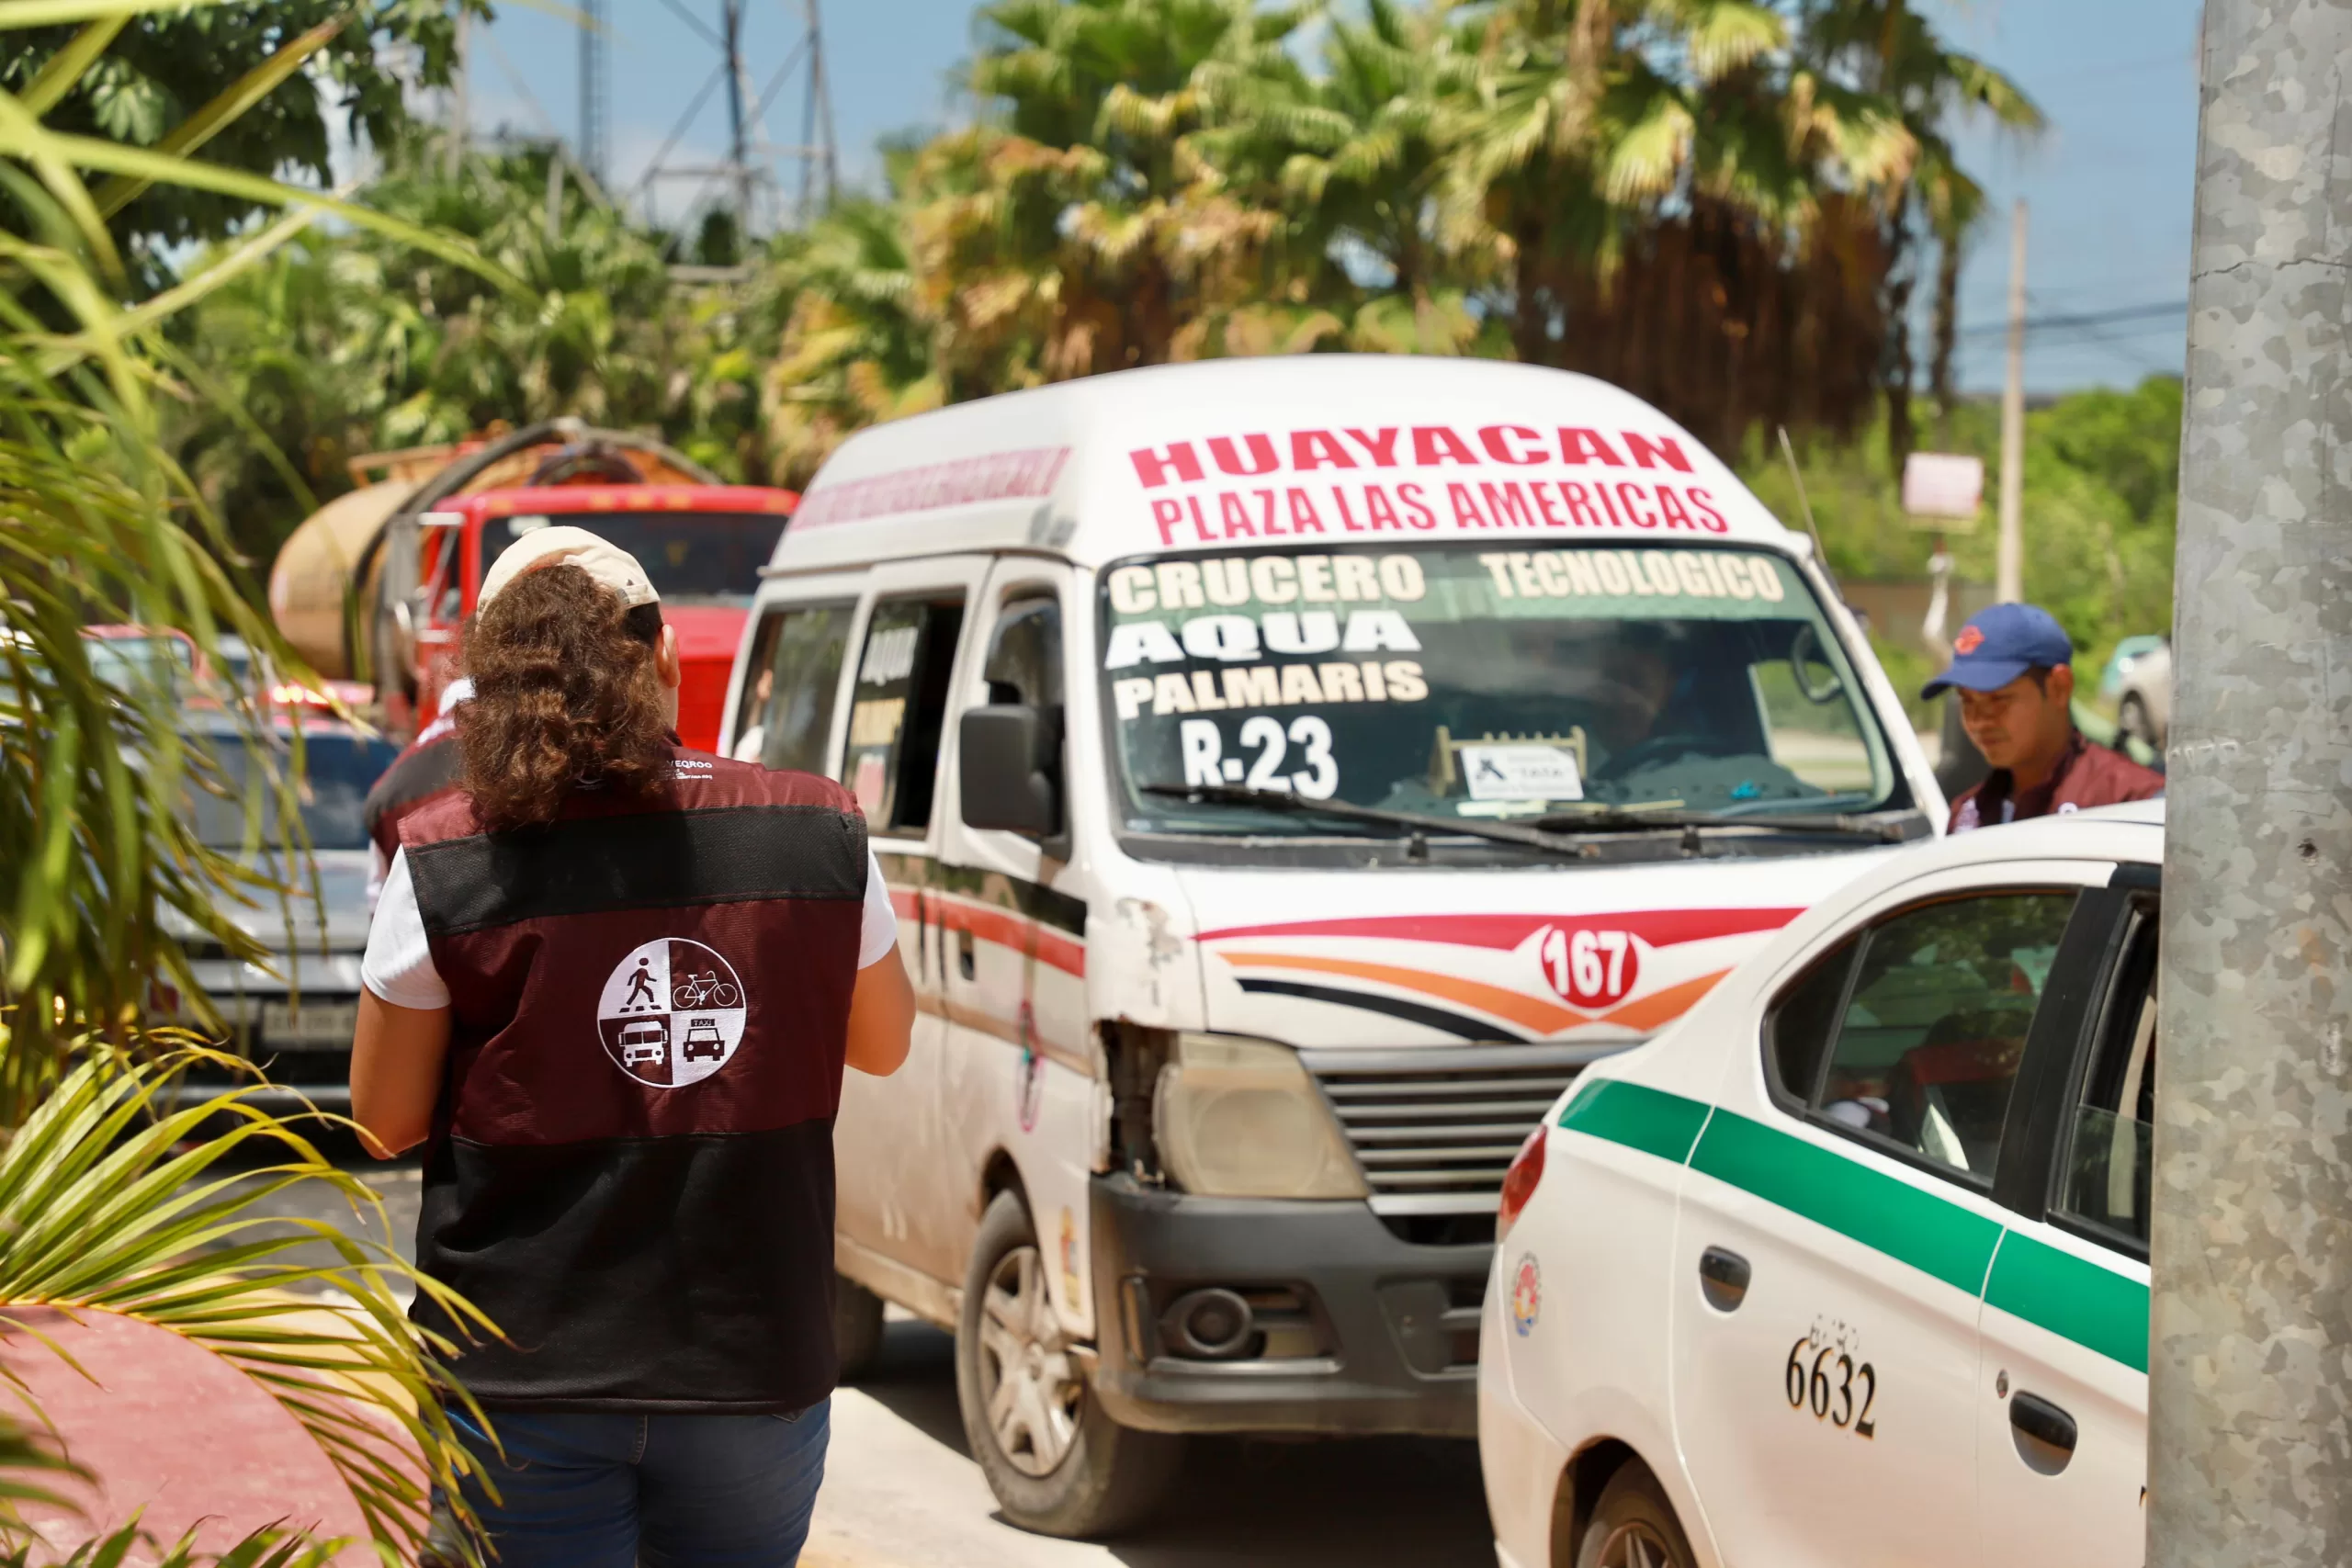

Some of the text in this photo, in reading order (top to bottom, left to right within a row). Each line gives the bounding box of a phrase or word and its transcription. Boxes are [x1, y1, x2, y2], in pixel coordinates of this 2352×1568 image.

[1129, 426, 1694, 490] HUAYACAN
[1150, 482, 1729, 546] PLAZA LAS AMERICAS
[1107, 550, 1784, 614] CRUCERO TECNOLOGICO
[1104, 609, 1423, 670] AQUA
[1113, 660, 1429, 721] PALMARIS
[1544, 929, 1629, 998] 167
[1786, 1337, 1876, 1440] 6632
